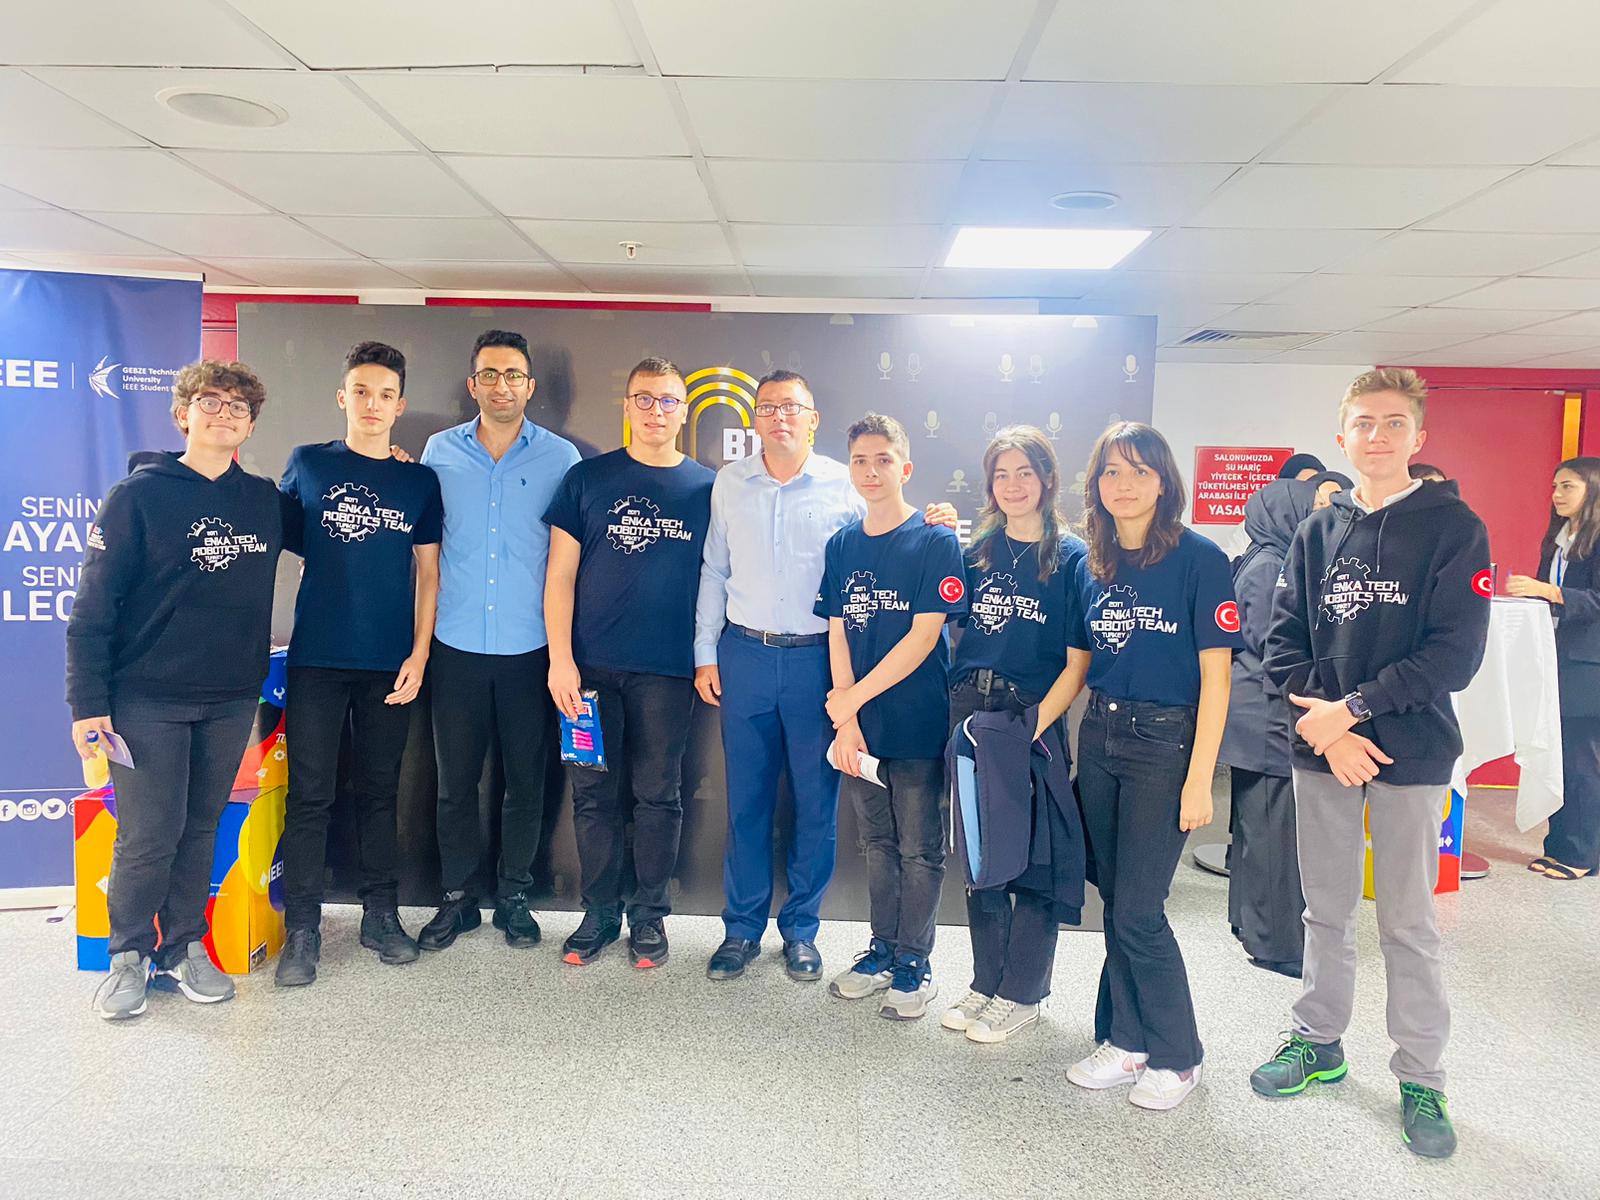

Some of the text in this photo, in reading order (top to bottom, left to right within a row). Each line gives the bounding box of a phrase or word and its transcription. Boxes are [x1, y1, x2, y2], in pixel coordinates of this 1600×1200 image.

[0, 359, 58, 388] EE
[122, 375, 161, 384] University
[122, 383, 139, 391] IEEE
[140, 384, 169, 392] Student
[1214, 454, 1273, 462] SALONUMUZDA
[1237, 463, 1261, 472] HARİÇ
[1210, 472, 1243, 480] YİYECEK
[1249, 473, 1276, 482] İÇECEK
[1198, 481, 1249, 490] TÜKETİLMESİ
[1198, 491, 1233, 500] ARABASI
[1234, 491, 1246, 500] İLE
[21, 493, 103, 518] SENİN
[338, 502, 404, 520] ENKA TECH
[323, 510, 413, 533] ROBOTICS TEAM
[336, 521, 360, 530] TURKEY
[621, 515, 683, 529] ENKA TECH
[608, 525, 692, 541] ROBOTICS TEAM
[204, 534, 257, 546] ENKA TECH
[192, 543, 267, 556] ROBOTICS TEAM
[1333, 580, 1399, 593] ENKA TECH
[872, 590, 897, 600] TECH
[982, 593, 1039, 609] ENKA TECH
[1376, 592, 1409, 605] TEAM
[881, 601, 909, 611] TEAM
[1015, 606, 1047, 625] TEAM
[1102, 606, 1163, 620] ENKA TECH
[1138, 618, 1178, 634] TEAM
